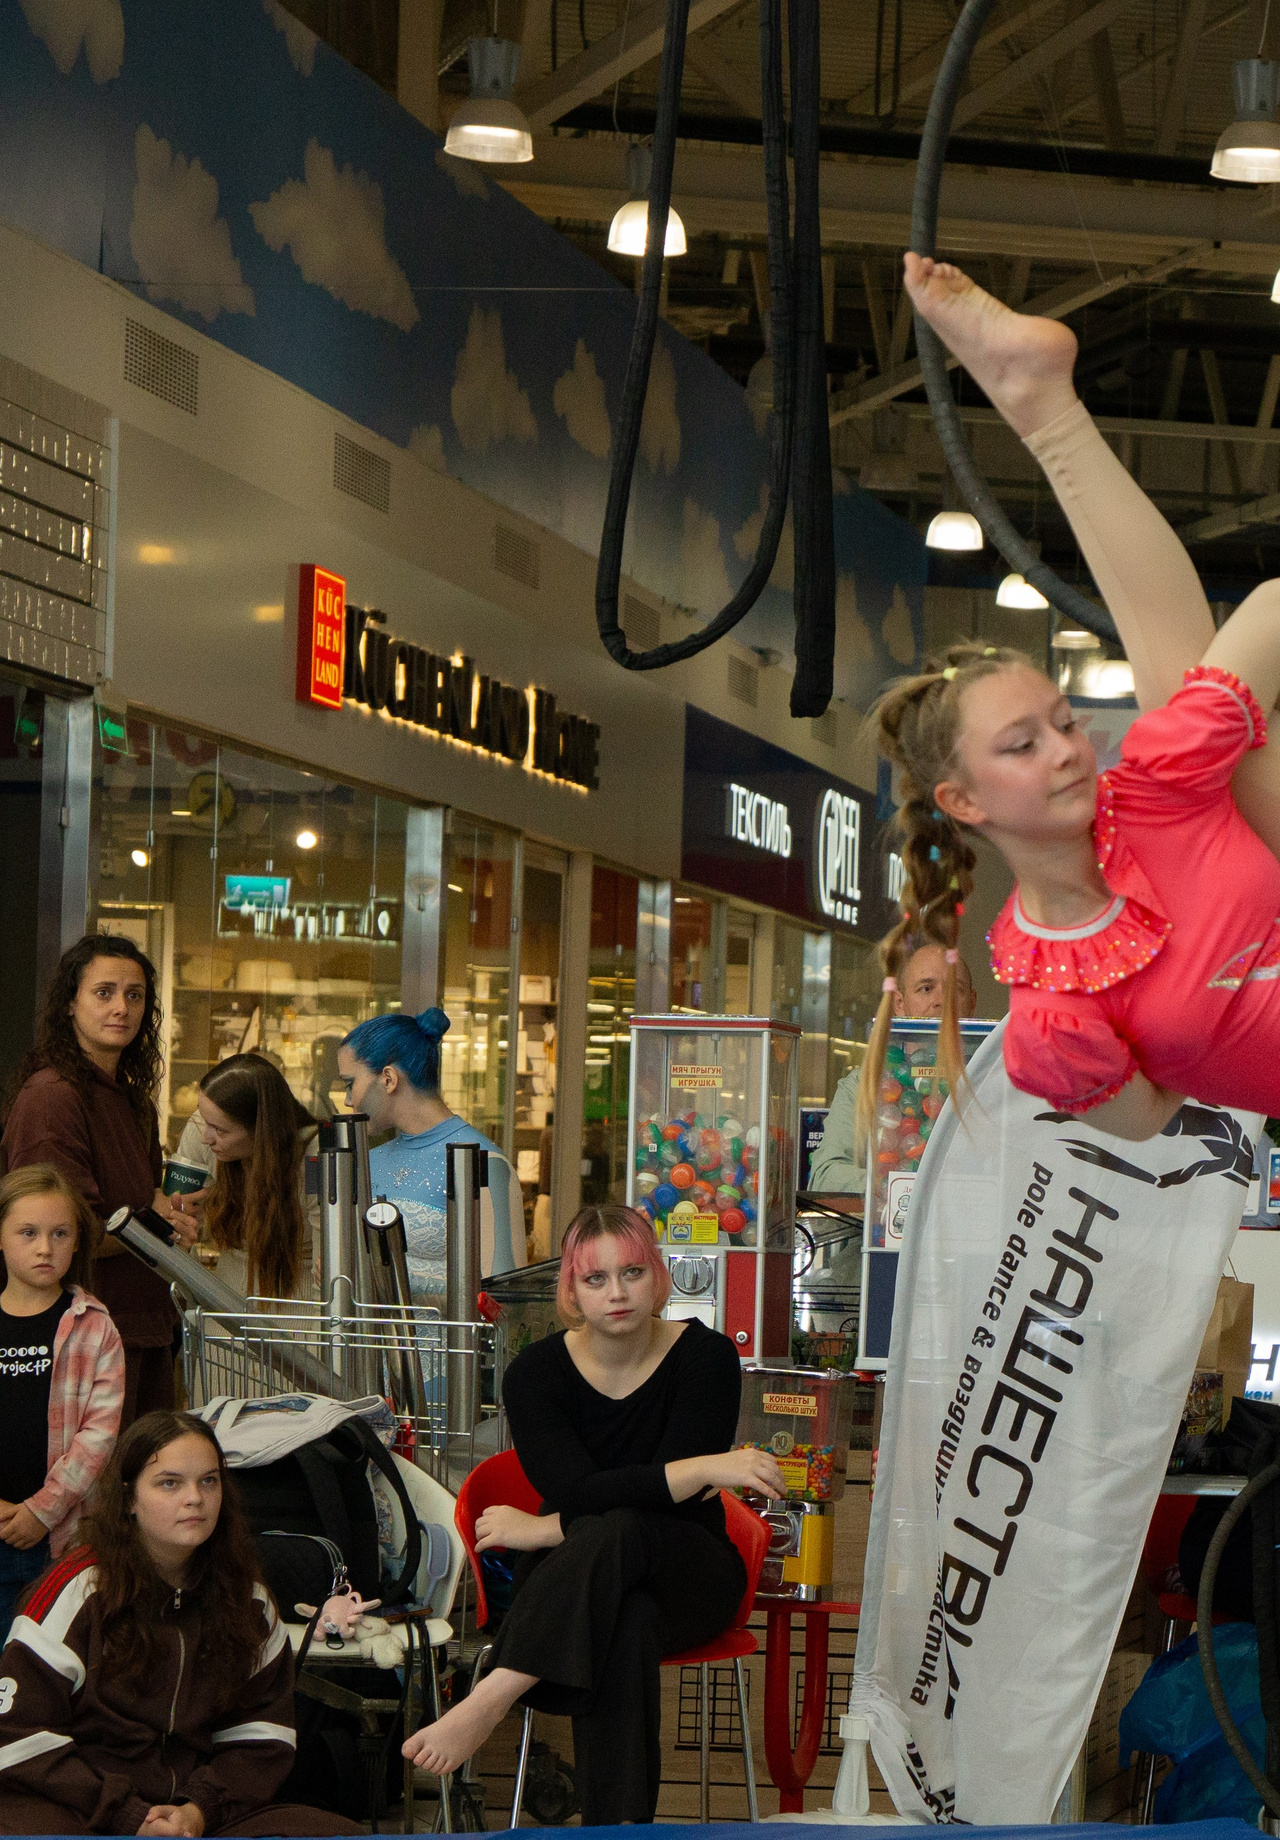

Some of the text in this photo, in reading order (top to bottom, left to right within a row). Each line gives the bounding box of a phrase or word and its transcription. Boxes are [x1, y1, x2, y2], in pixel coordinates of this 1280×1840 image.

[318, 587, 341, 619] KÜC
[316, 622, 340, 653] HEN
[315, 657, 339, 688] LAND
[731, 783, 791, 858] ТЕКСТИЛЬ
[672, 1066, 722, 1075] МЯЧ ПРЫГУН
[678, 1079, 717, 1087] ИГРУШКА
[1016, 1161, 1054, 1229] pole
[981, 1233, 1029, 1322] dance
[971, 1325, 997, 1349] &
[765, 1403, 817, 1415] НЕСКОЛЬКО ШТУК
[769, 1395, 810, 1405] КОНФЕТЫ
